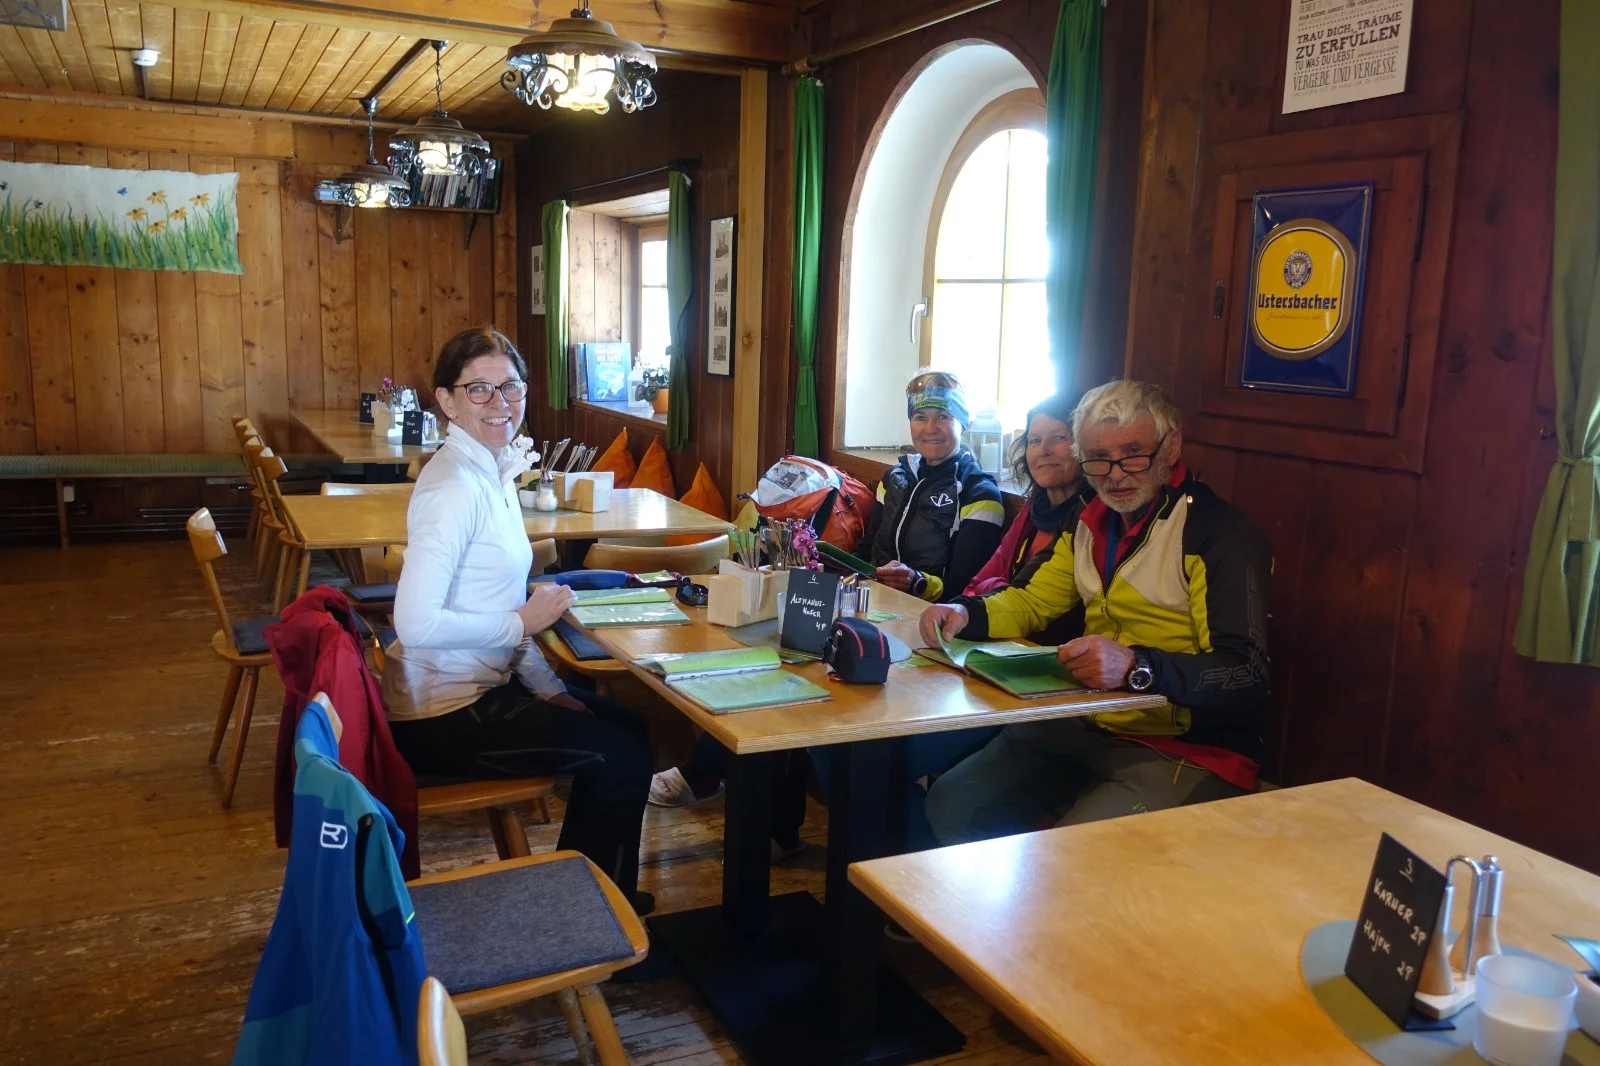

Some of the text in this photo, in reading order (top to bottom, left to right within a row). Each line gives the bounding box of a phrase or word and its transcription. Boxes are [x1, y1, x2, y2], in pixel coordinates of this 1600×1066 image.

[1295, 44, 1315, 60] ZU
[1320, 24, 1401, 54] ERFÜLLEN
[1297, 11, 1402, 44] TRAU DICH, TRÄUME
[1293, 72, 1331, 91] VERGEBE
[1333, 66, 1351, 84] UND
[1353, 56, 1396, 80] VERGESSE
[1295, 59, 1304, 71] TU
[1305, 57, 1320, 69] WAS
[1321, 54, 1332, 66] DU
[1332, 48, 1356, 64] LIEBST
[1258, 293, 1338, 309] Ustersbacher
[1405, 858, 1414, 875] 3
[1373, 877, 1415, 924] KARNER
